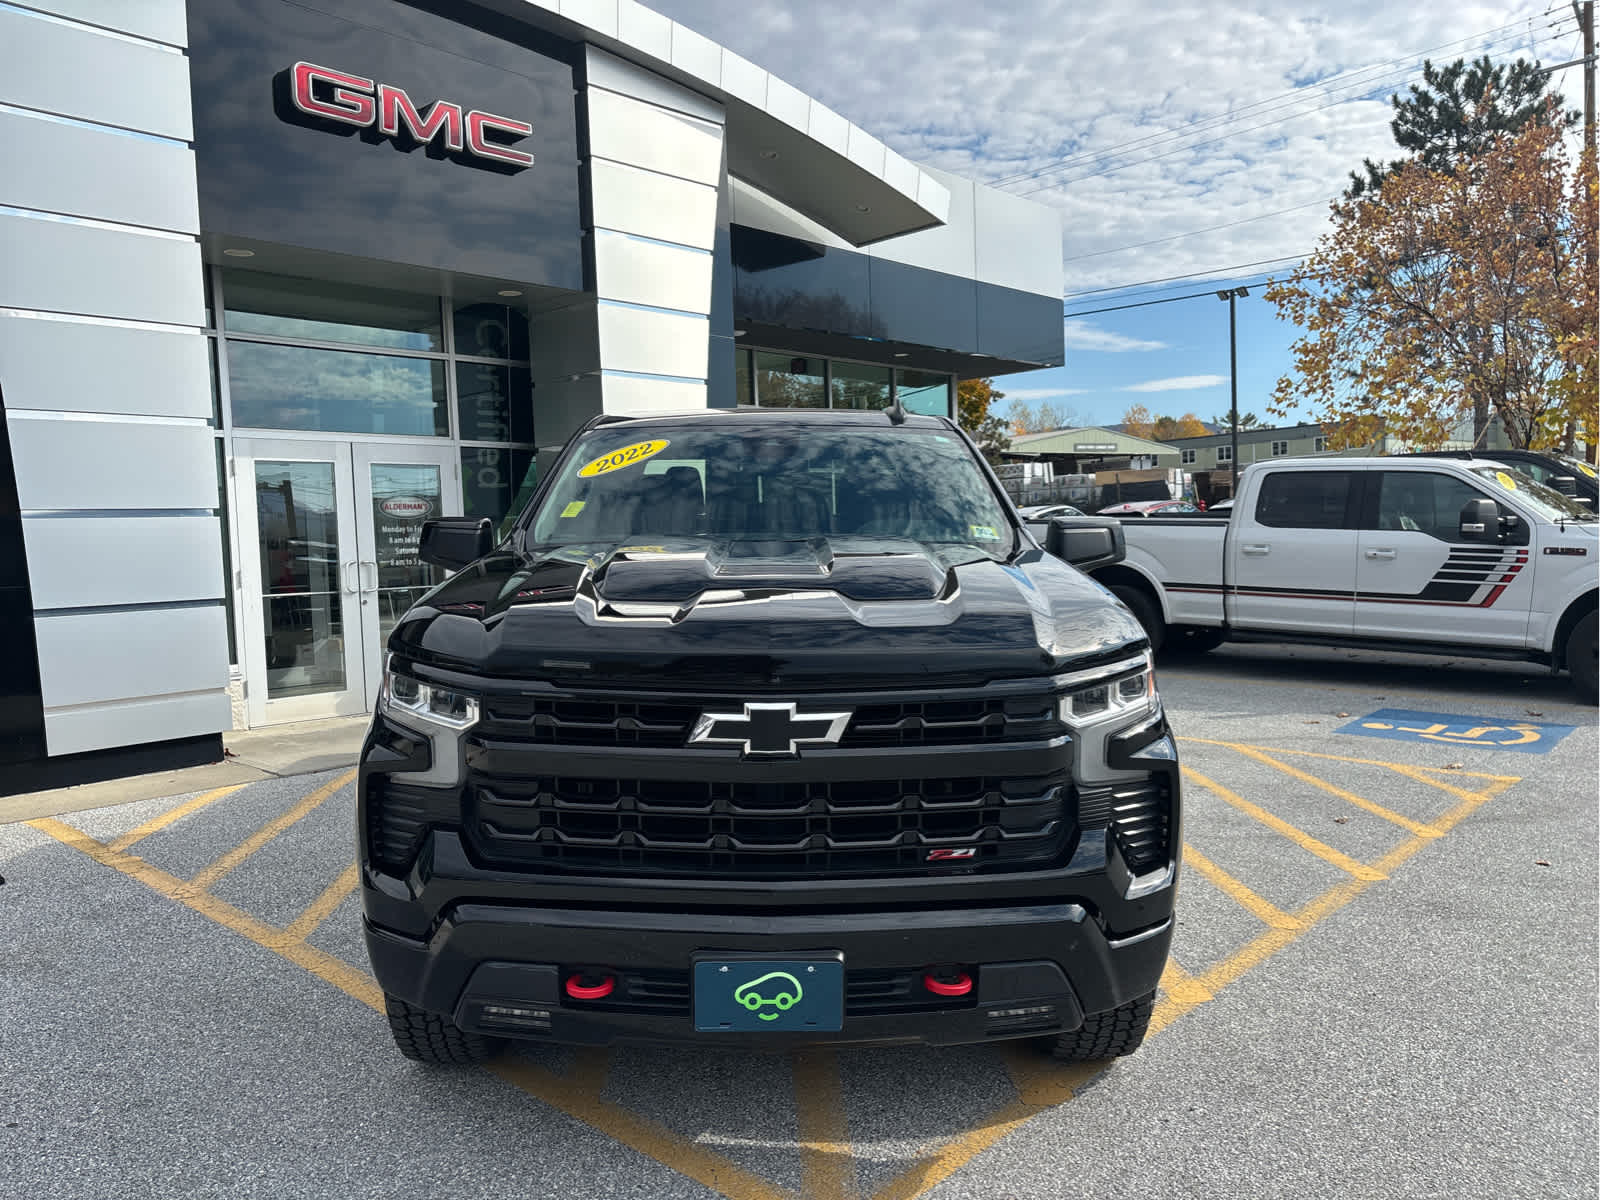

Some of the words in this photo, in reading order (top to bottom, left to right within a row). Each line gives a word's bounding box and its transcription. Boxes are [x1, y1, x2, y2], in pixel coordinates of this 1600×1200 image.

[291, 60, 534, 168] GMC
[476, 319, 509, 489] Certified
[595, 443, 654, 472] 2022
[384, 503, 428, 511] ALDERMAN'S
[382, 525, 405, 534] Monday
[395, 547, 419, 555] Saturda
